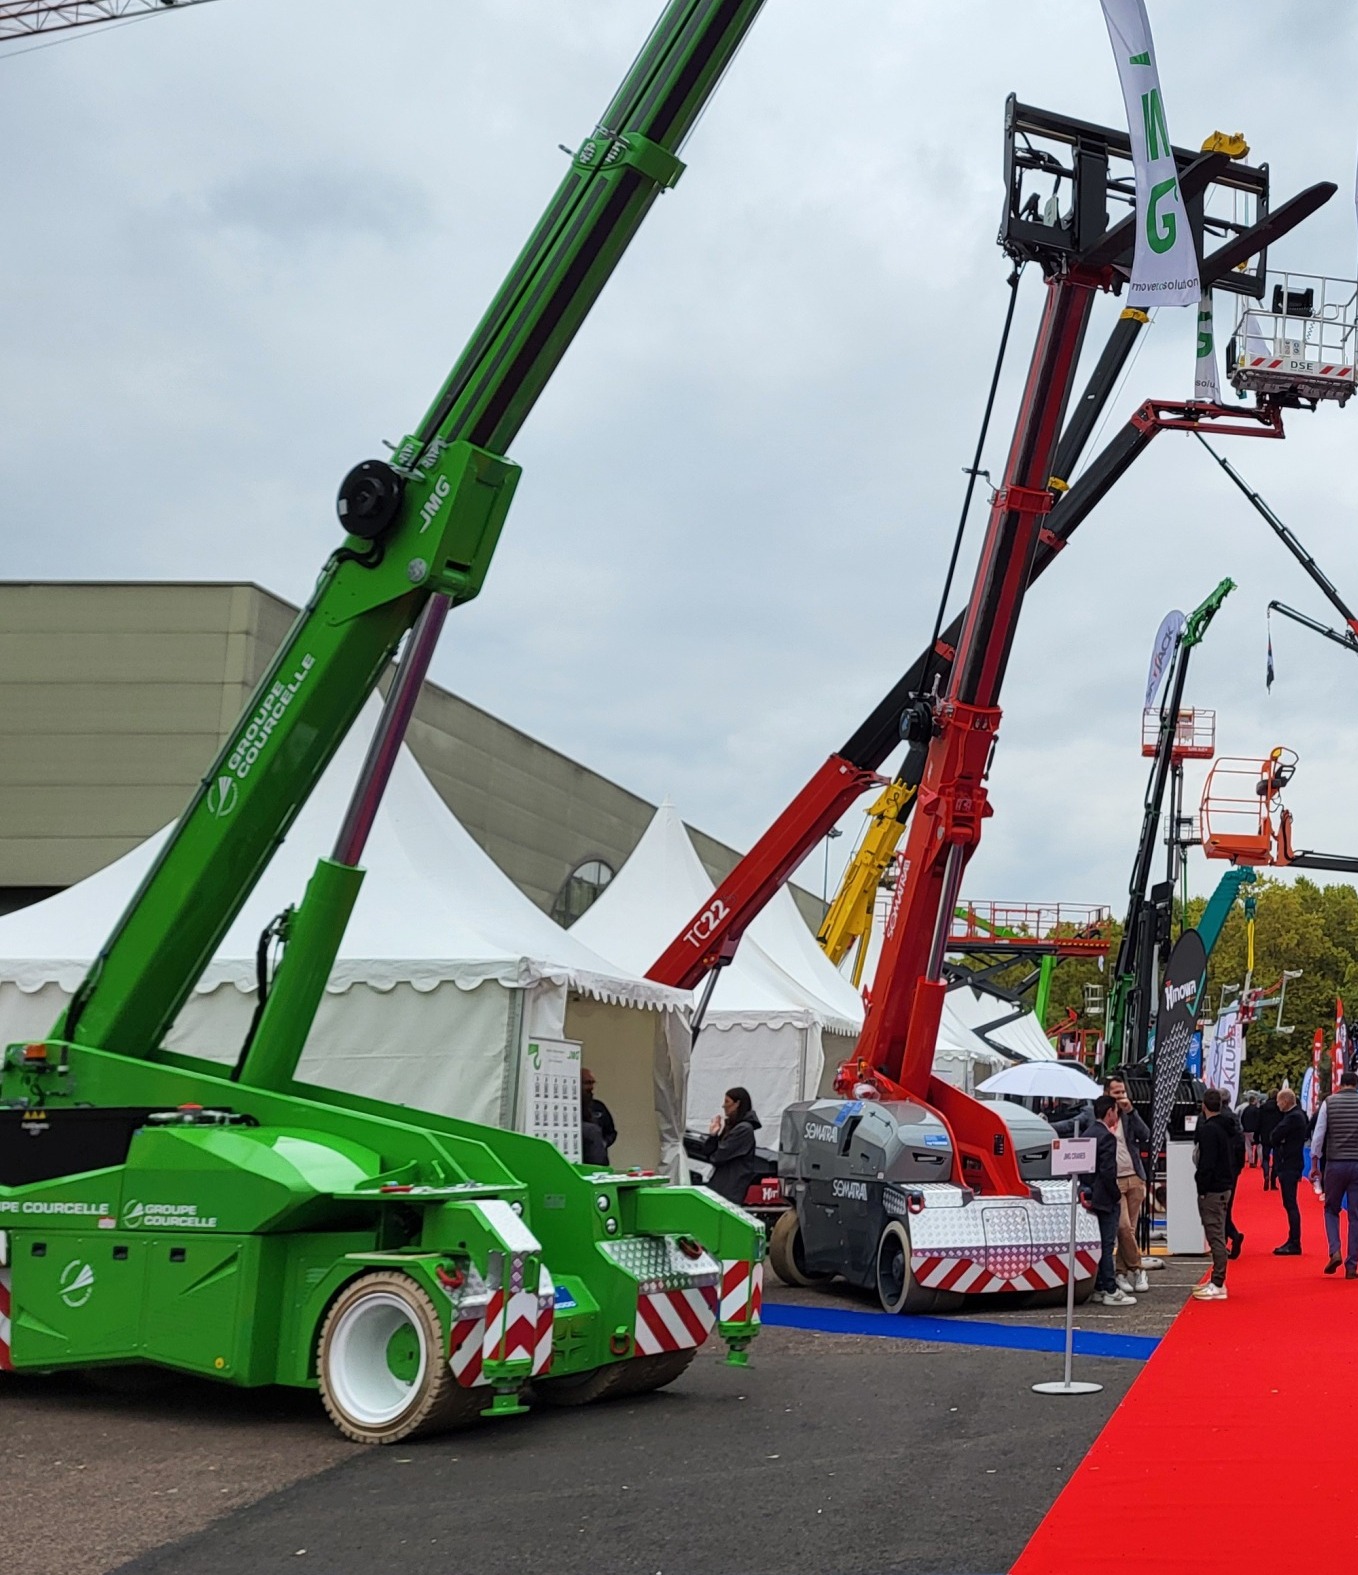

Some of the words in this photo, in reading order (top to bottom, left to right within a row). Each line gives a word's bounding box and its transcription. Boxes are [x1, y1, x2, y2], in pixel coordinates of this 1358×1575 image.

[1290, 361, 1313, 370] DSE
[420, 474, 451, 534] JMG
[228, 680, 285, 770] GROUPE
[236, 653, 316, 779] COURCELLE
[683, 899, 730, 948] TC22
[0, 1202, 19, 1214] PE
[22, 1202, 110, 1216] COURCELLE
[143, 1215, 218, 1229] COURCELLE
[144, 1204, 198, 1216] GROUPE
